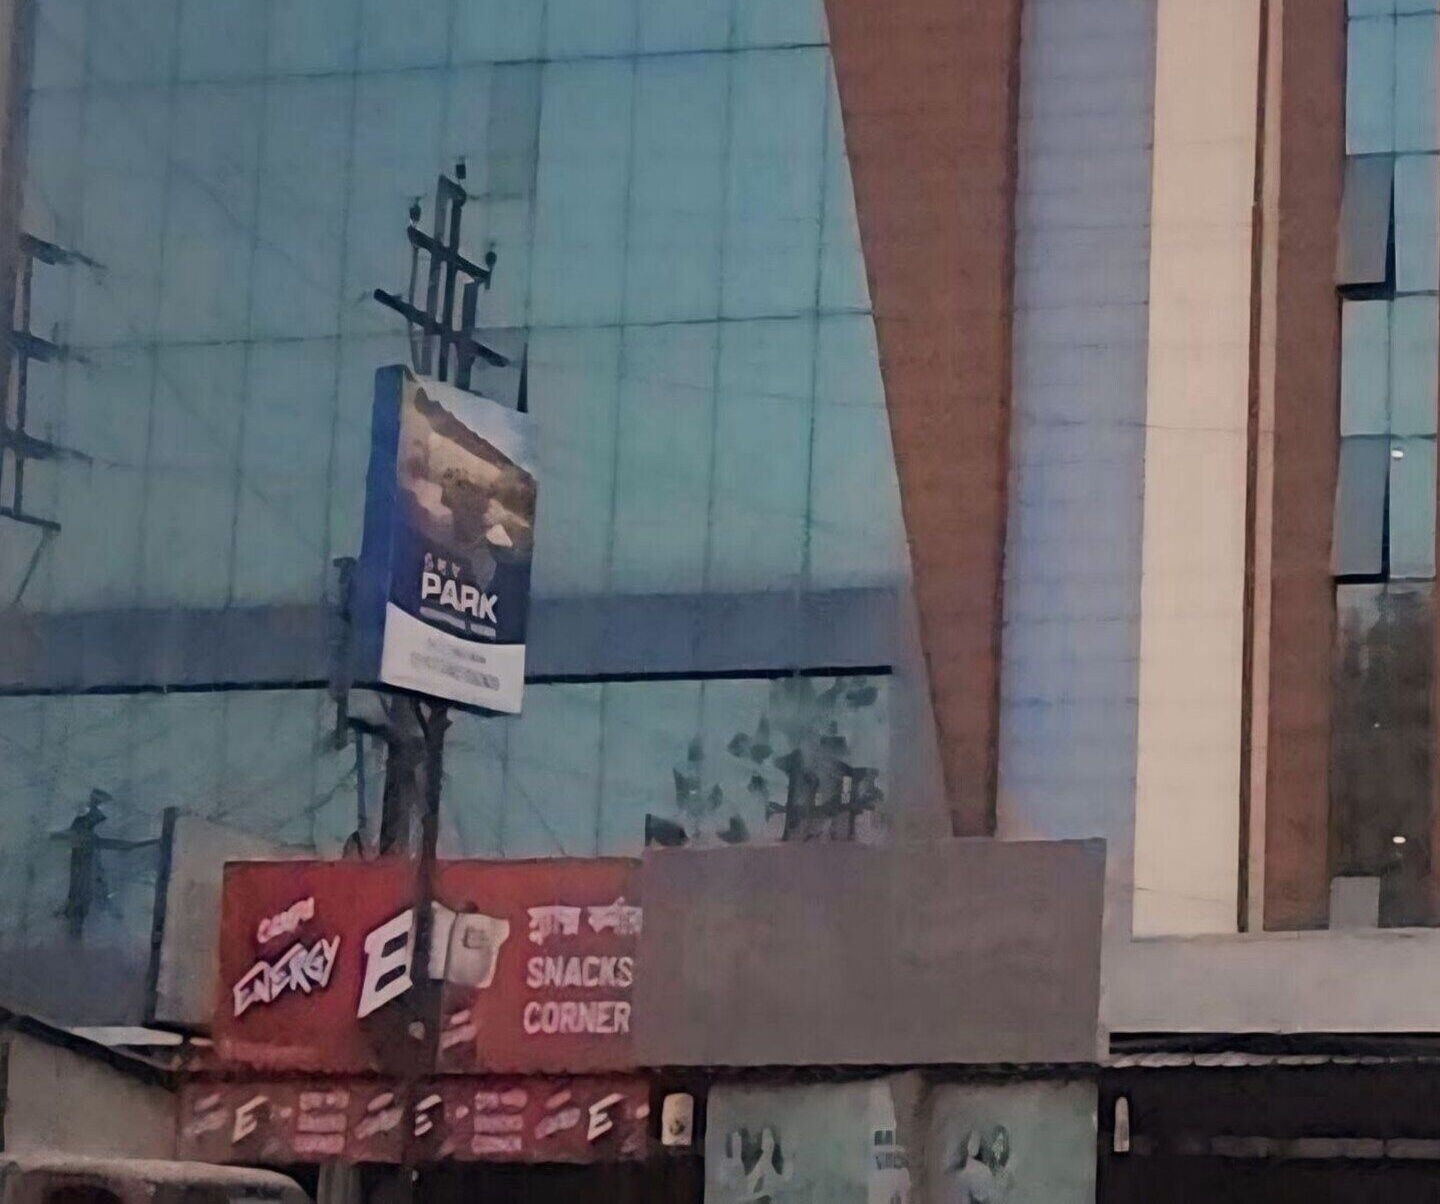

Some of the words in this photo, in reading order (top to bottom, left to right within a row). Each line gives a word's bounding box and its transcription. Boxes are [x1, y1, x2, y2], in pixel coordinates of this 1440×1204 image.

[420, 571, 498, 624] PARK
[525, 955, 635, 989] SNACKS
[523, 1000, 631, 1035] CORNER
